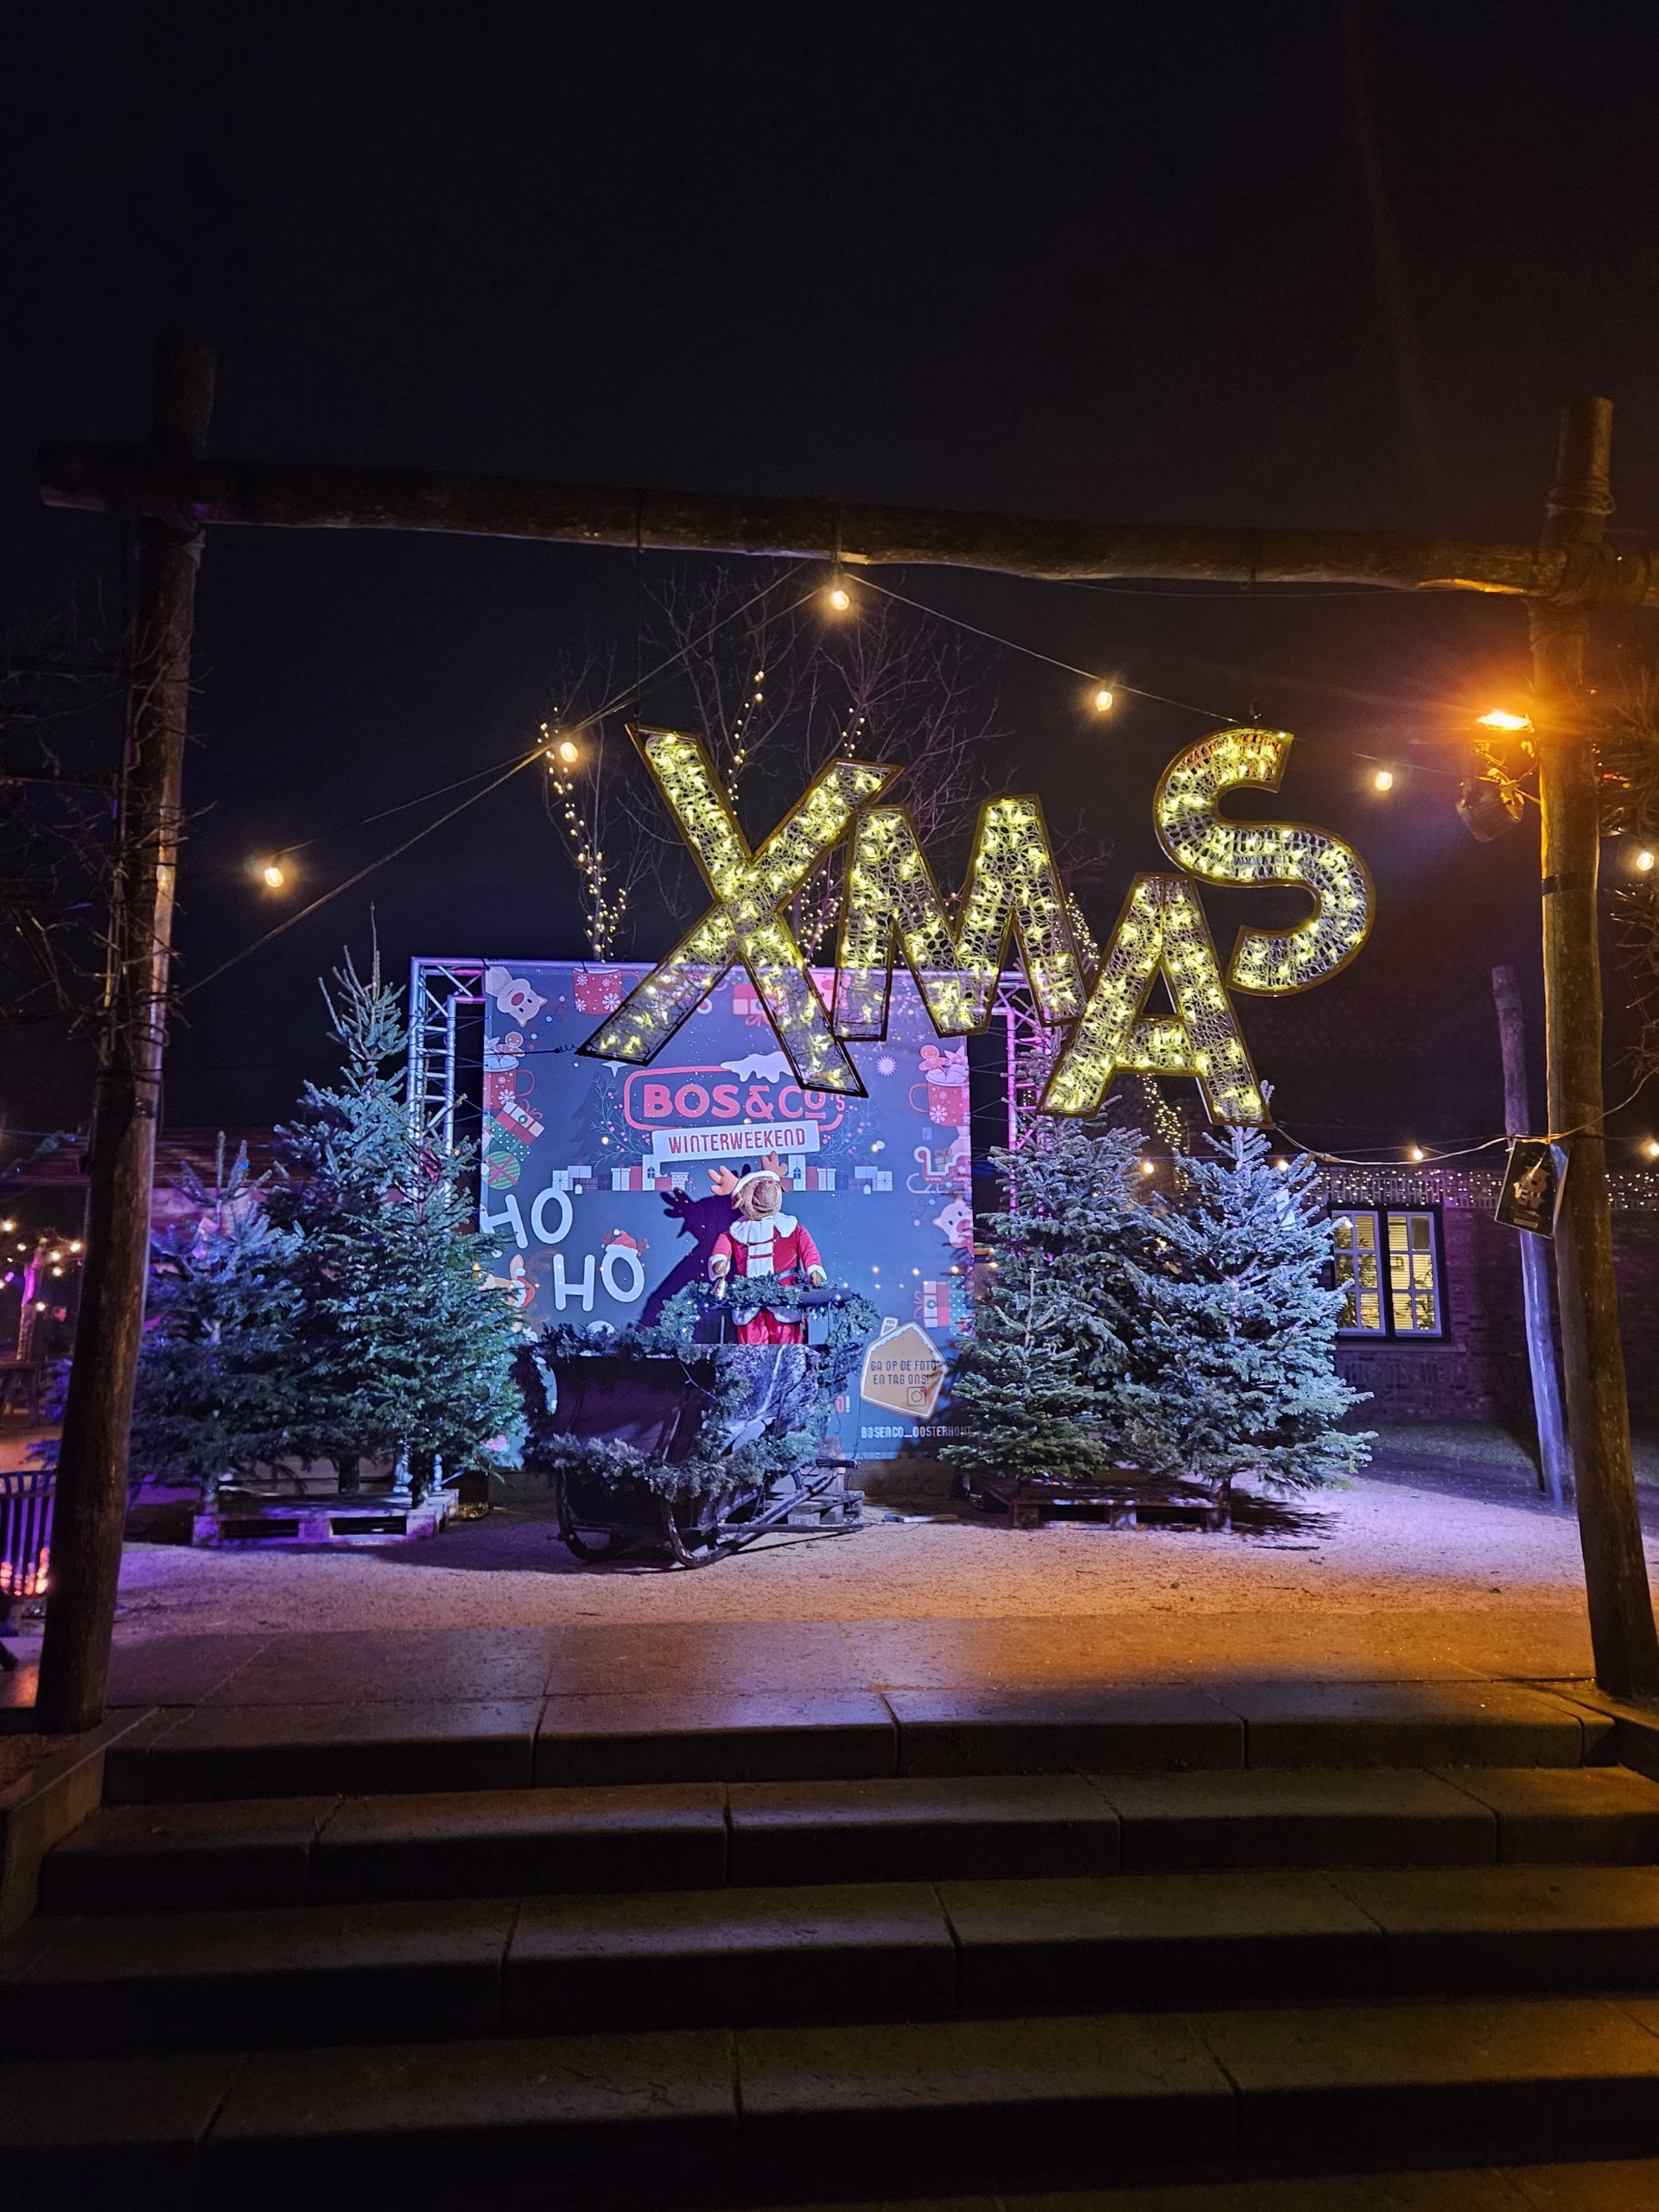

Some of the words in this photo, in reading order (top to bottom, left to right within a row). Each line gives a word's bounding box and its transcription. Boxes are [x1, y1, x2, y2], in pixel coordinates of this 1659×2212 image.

[575, 724, 1376, 1129] XMAS
[668, 1128, 806, 1154] WINTERWEEKEND
[480, 1187, 574, 1249] HO
[553, 1250, 645, 1312] HO
[870, 1360, 882, 1371] GA
[886, 1360, 898, 1371] OP
[900, 1360, 912, 1371] DE
[915, 1360, 937, 1371] FOTO
[874, 1374, 885, 1385] EN
[887, 1374, 905, 1385] TAG
[908, 1374, 930, 1385] ONS!
